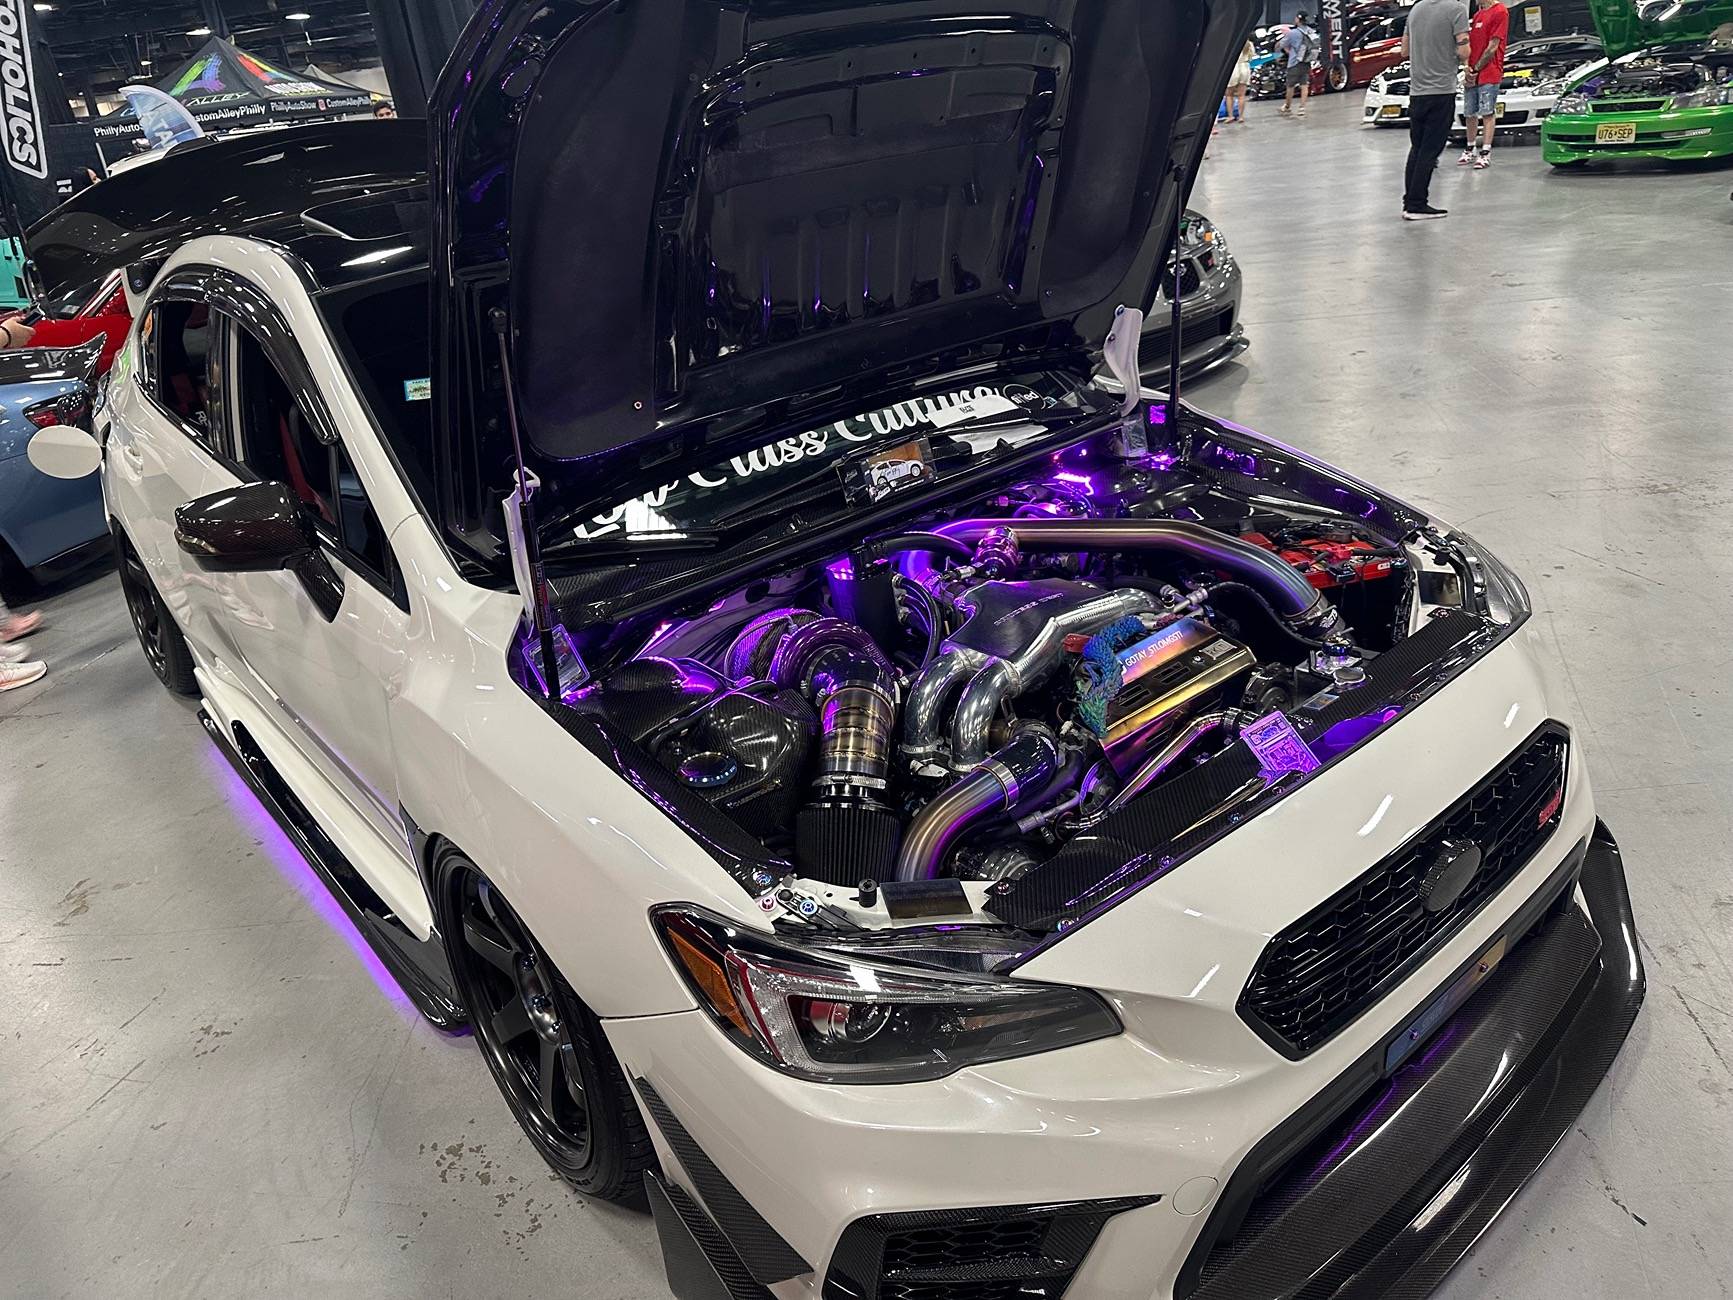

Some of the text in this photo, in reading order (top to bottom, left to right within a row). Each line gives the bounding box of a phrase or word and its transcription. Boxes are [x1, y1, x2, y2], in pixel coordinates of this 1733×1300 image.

[1330, 0, 1343, 59] MENT
[185, 91, 250, 107] ALLEY
[195, 103, 266, 122] stomAlleyPhilly
[93, 123, 145, 137] PhillyAuto
